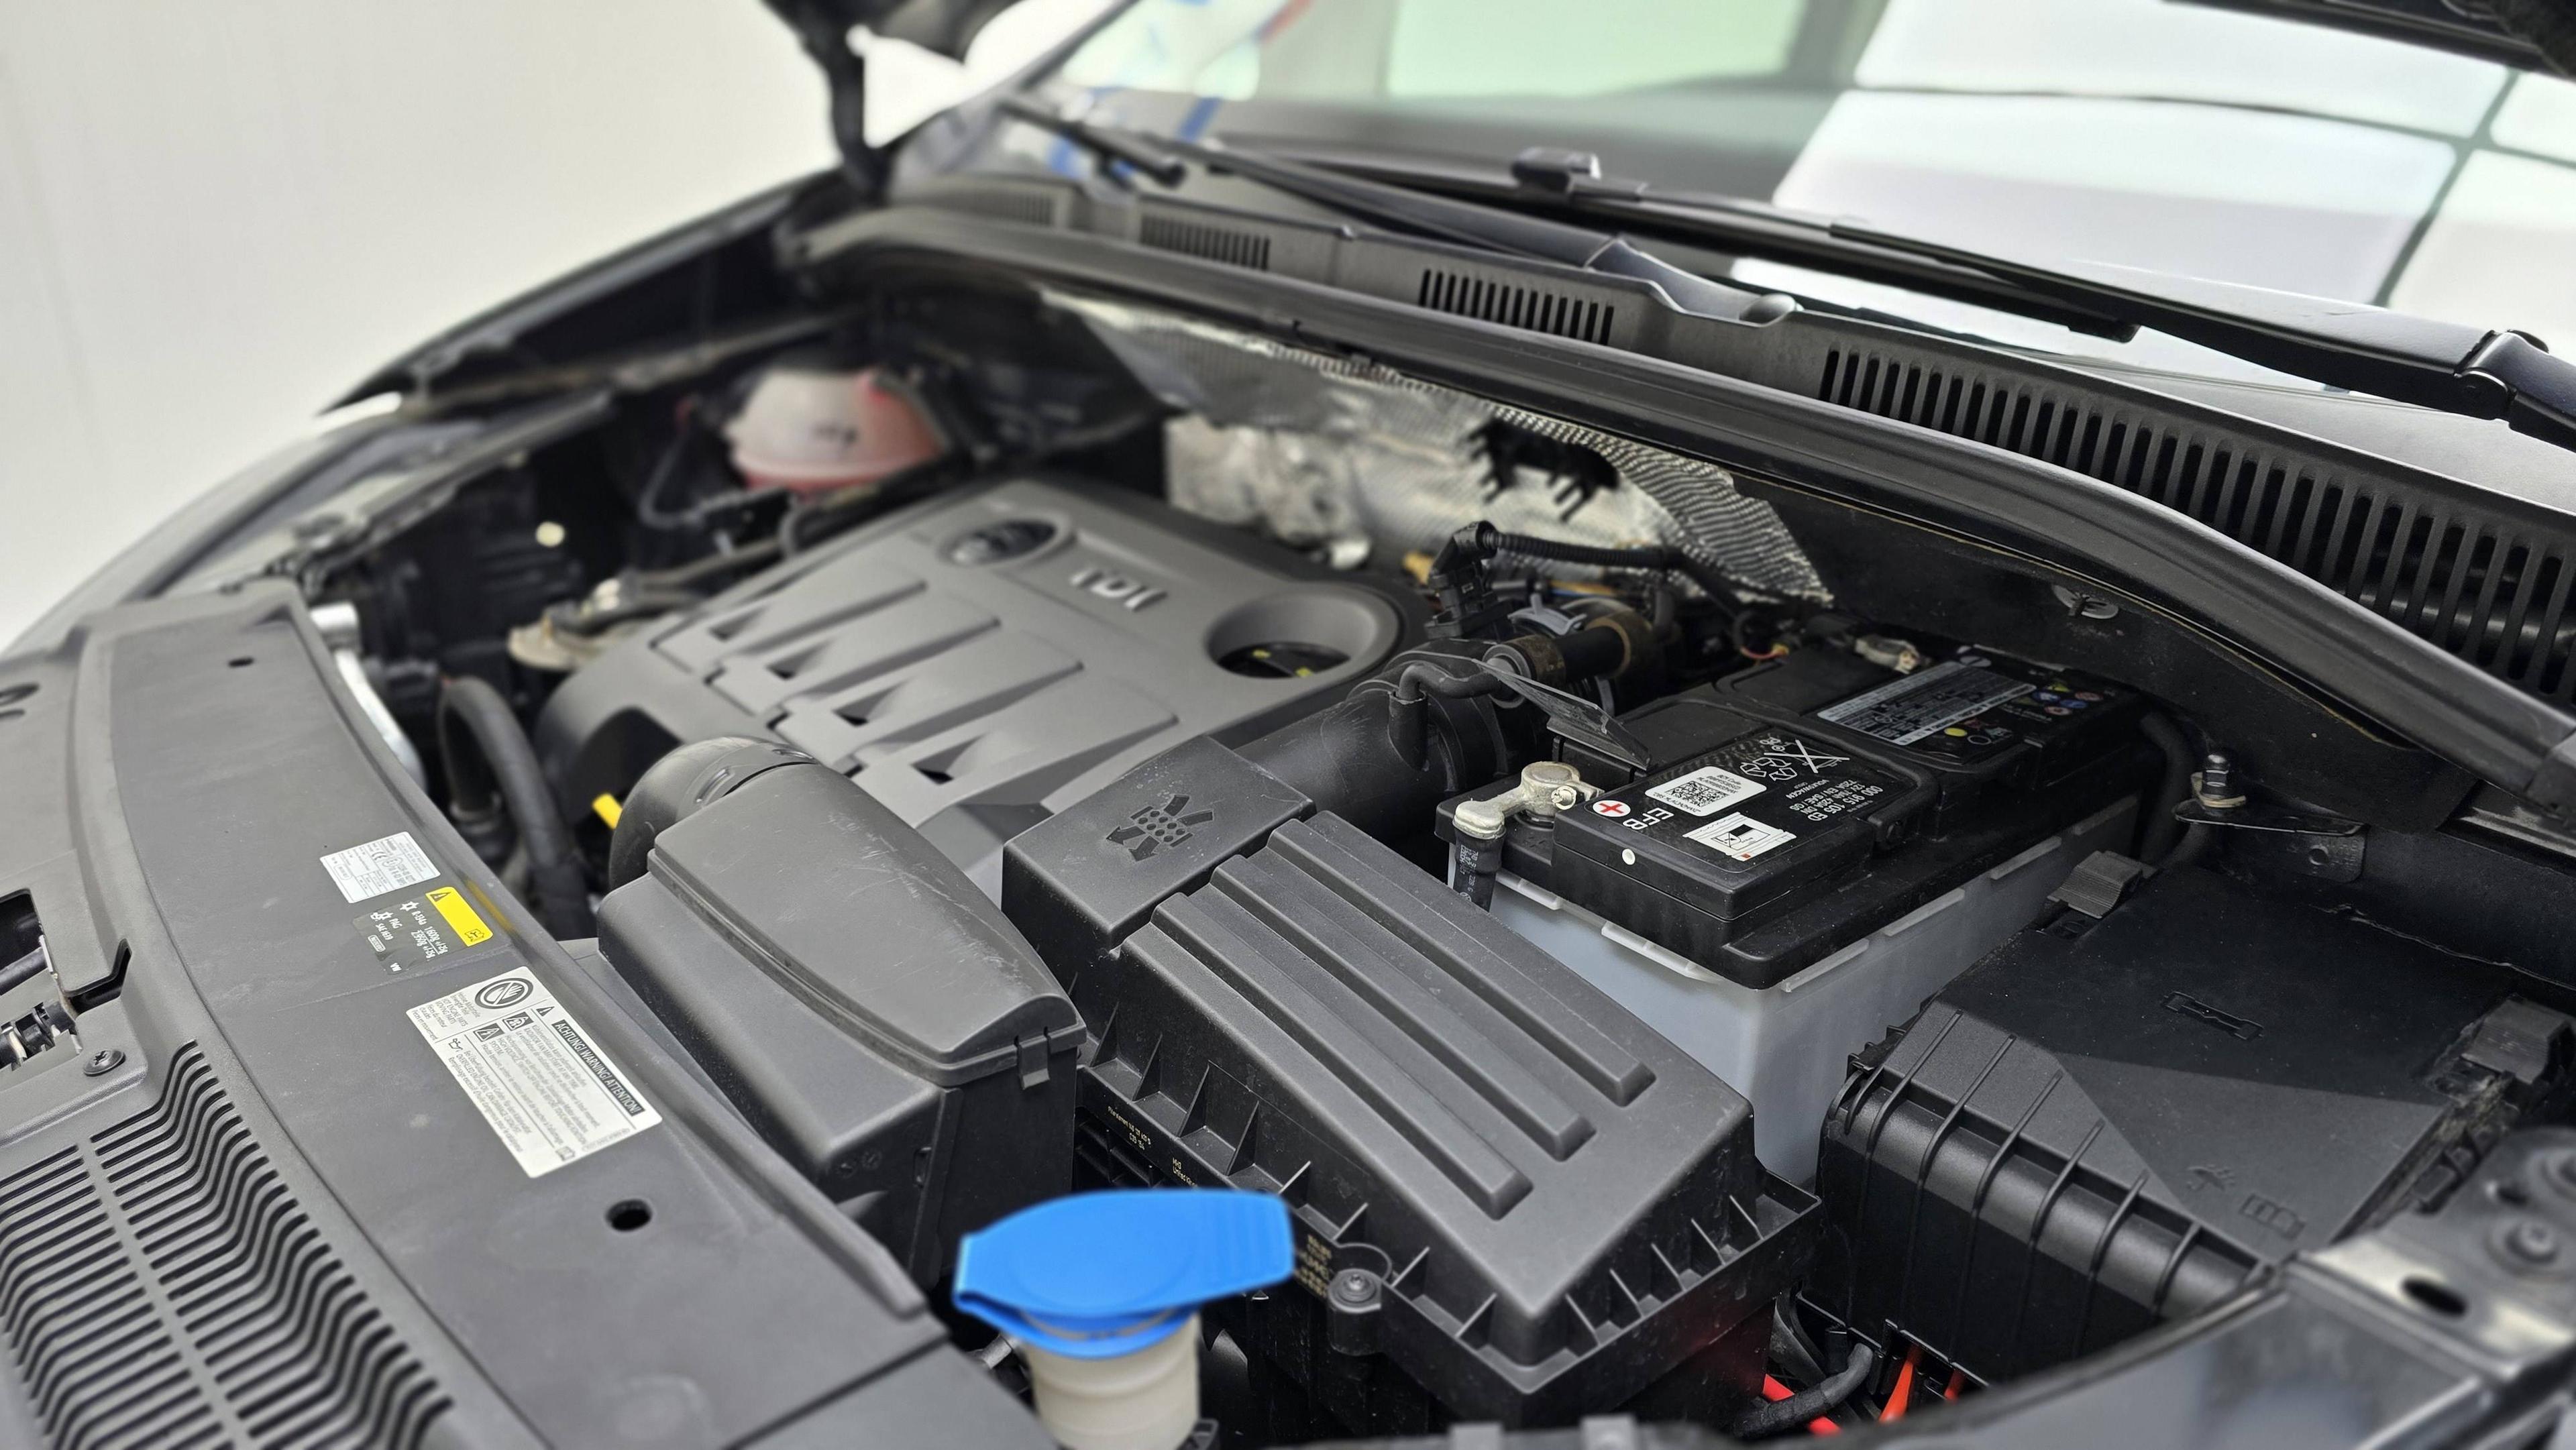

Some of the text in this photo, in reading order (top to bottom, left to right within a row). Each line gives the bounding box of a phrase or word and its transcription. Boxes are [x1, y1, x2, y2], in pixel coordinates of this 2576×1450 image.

[1786, 779, 1829, 799] VOLKSWAGEN
[1861, 786, 1883, 795] 000
[1805, 794, 1823, 803] SAE
[1843, 794, 1865, 804] 915
[1823, 803, 1845, 814] 105
[1622, 807, 1674, 830] EFB
[1808, 810, 1827, 821] ED
[389, 918, 402, 928] PAG
[412, 911, 427, 925] R-134a
[376, 923, 387, 932] SAE
[555, 1023, 586, 1052] ACHTUNG!
[580, 1050, 611, 1080] WARNING!
[605, 1079, 641, 1113] ATTENTION!
